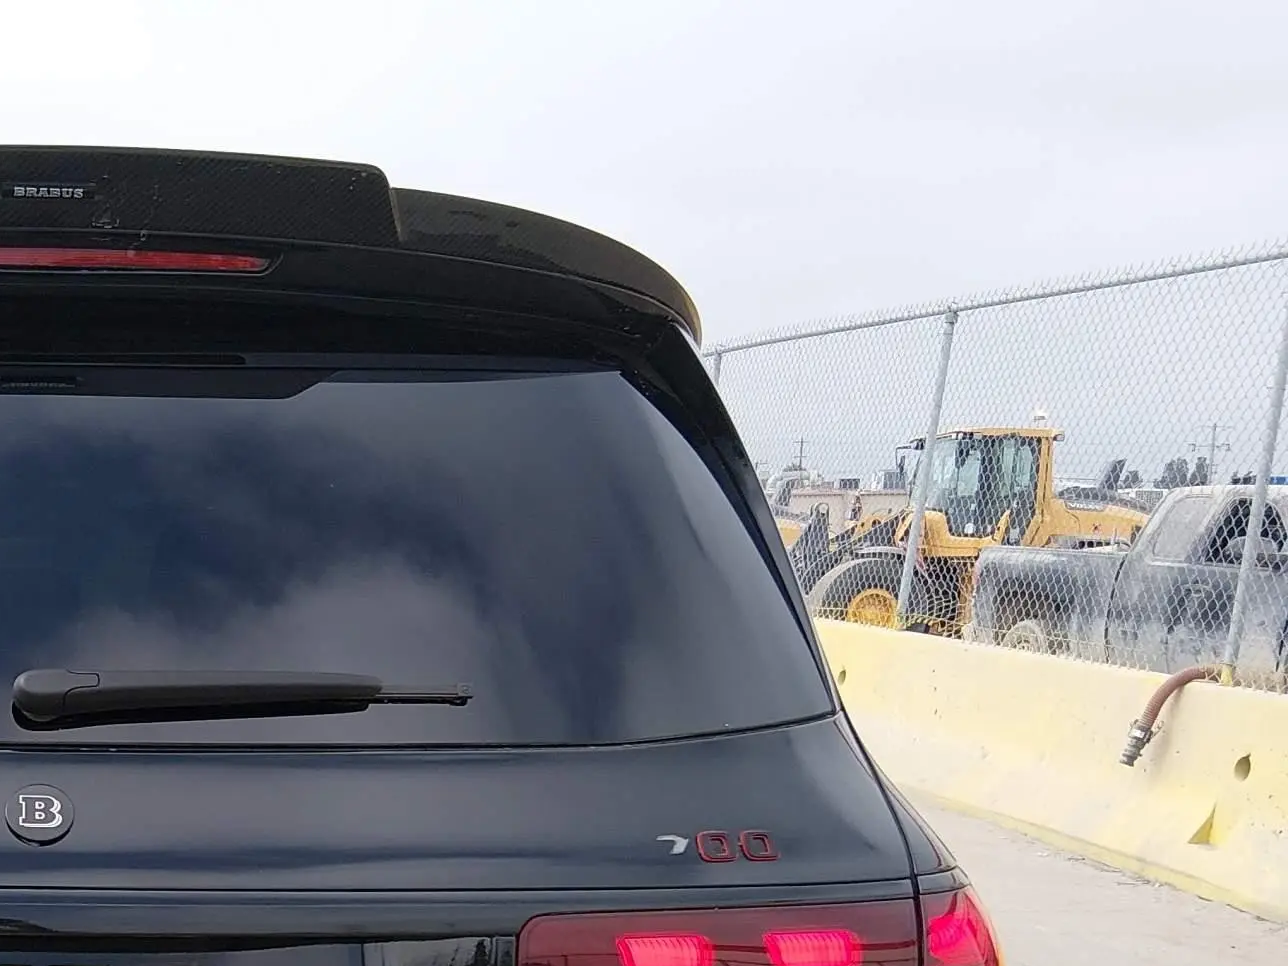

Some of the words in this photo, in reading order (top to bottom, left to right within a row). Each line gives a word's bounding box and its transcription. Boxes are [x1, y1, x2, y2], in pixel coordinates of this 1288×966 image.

[13, 186, 83, 198] BRABUS
[19, 795, 63, 827] B
[655, 829, 781, 863] 700
